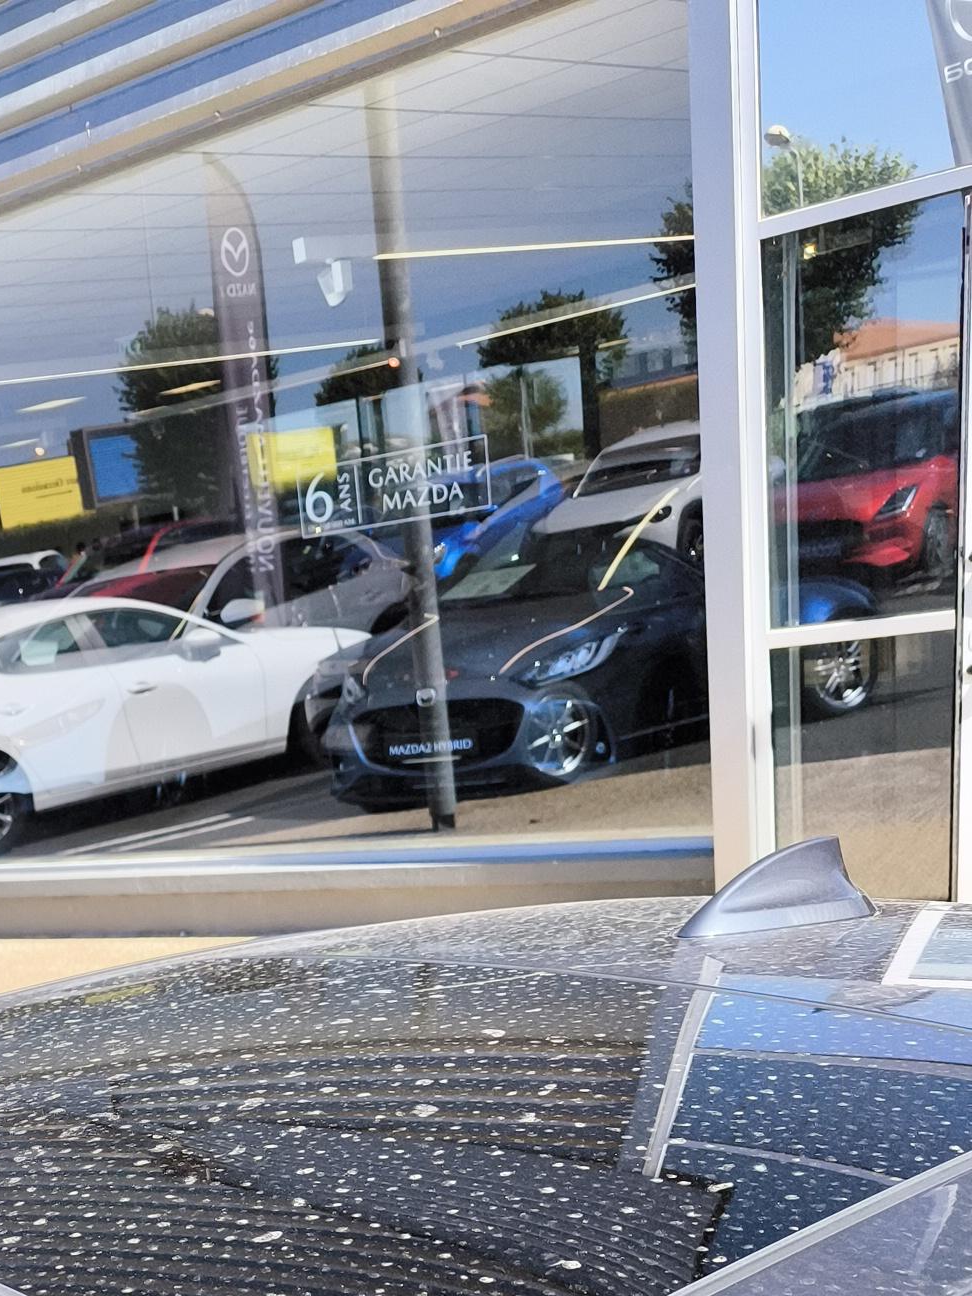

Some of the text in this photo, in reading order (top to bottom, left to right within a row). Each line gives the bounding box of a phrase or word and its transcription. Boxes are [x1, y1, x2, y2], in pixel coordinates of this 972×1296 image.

[368, 450, 474, 488] GARANTIE
[305, 471, 354, 523] 6 ANS
[381, 480, 465, 514] MAZDA
[388, 738, 473, 757] MAZDA2 HYBRID
